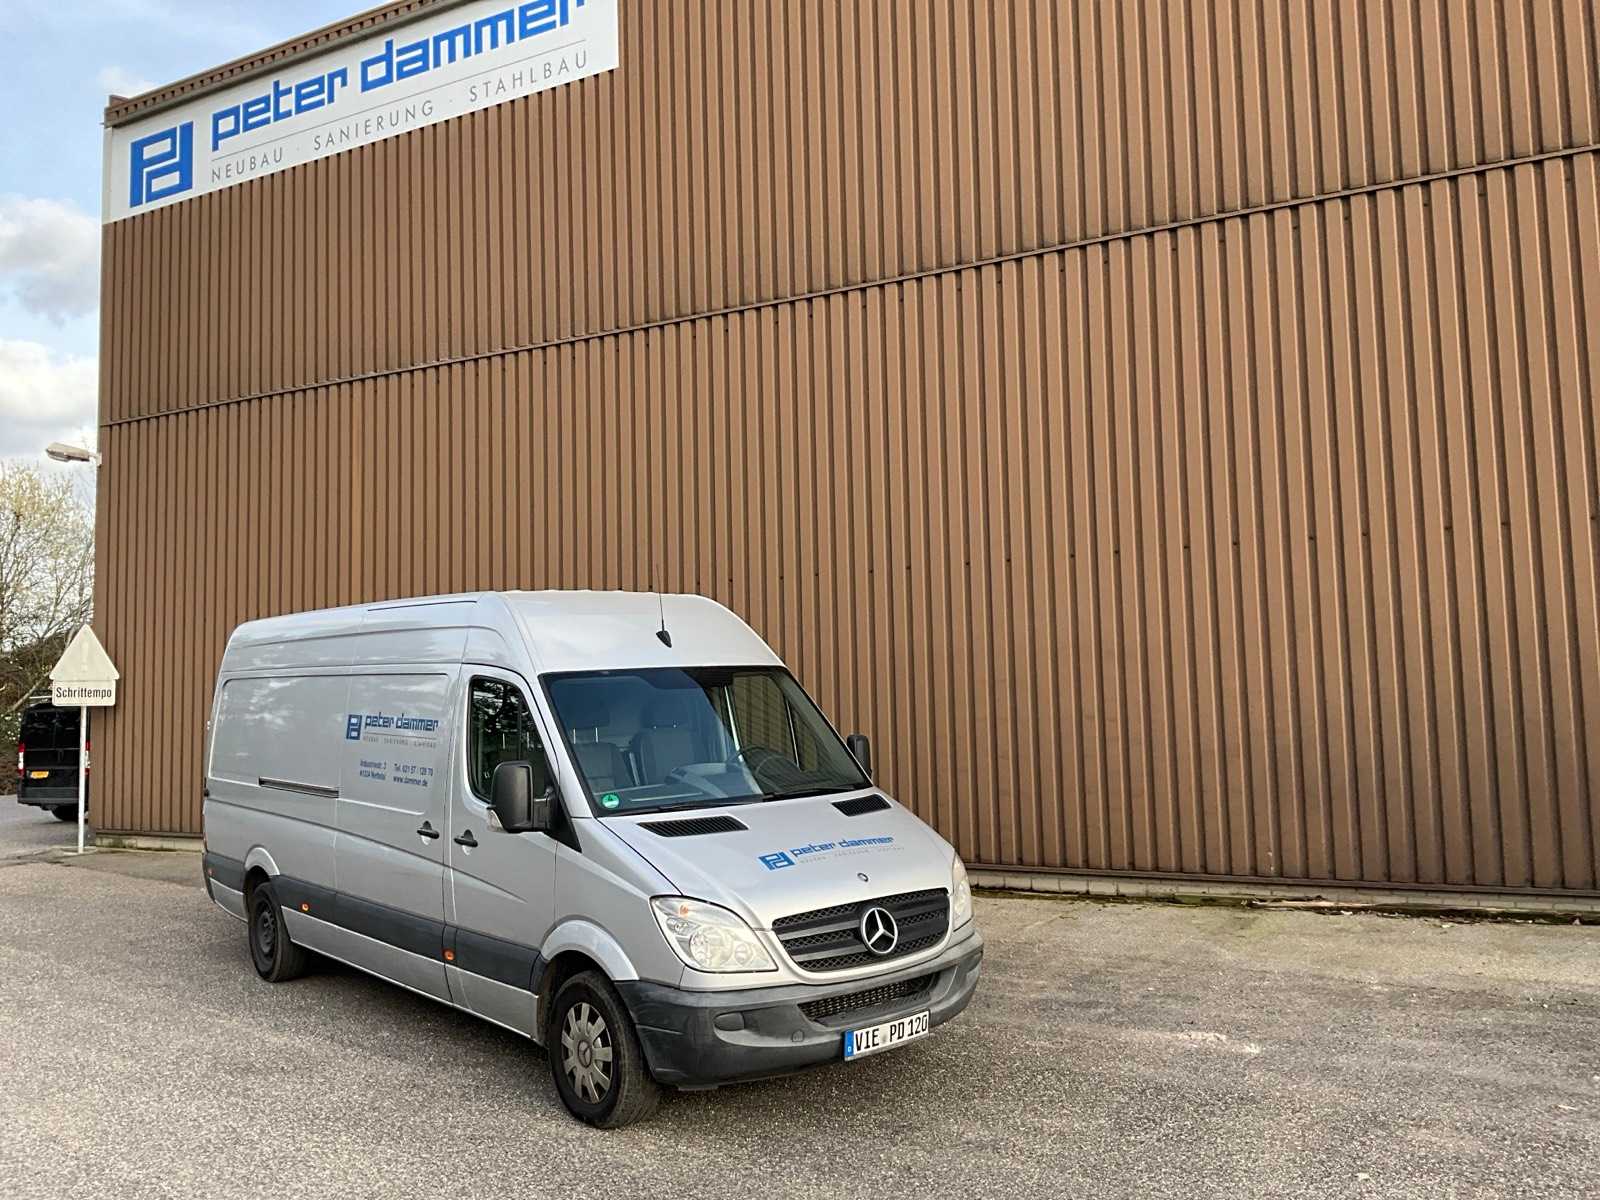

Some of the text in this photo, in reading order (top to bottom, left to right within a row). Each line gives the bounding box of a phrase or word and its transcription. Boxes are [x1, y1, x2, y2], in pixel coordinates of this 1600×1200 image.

[211, 50, 587, 182] NEUBAU SANIERUNG STAHLBAU
[212, 67, 348, 152] peter
[56, 687, 112, 699] Schrittempo
[364, 712, 439, 731] peter dammer
[790, 842, 835, 857] peter
[839, 836, 894, 848] dammer
[855, 1028, 880, 1051] VIE
[889, 1022, 905, 1042] PD
[907, 1014, 928, 1037] 120
